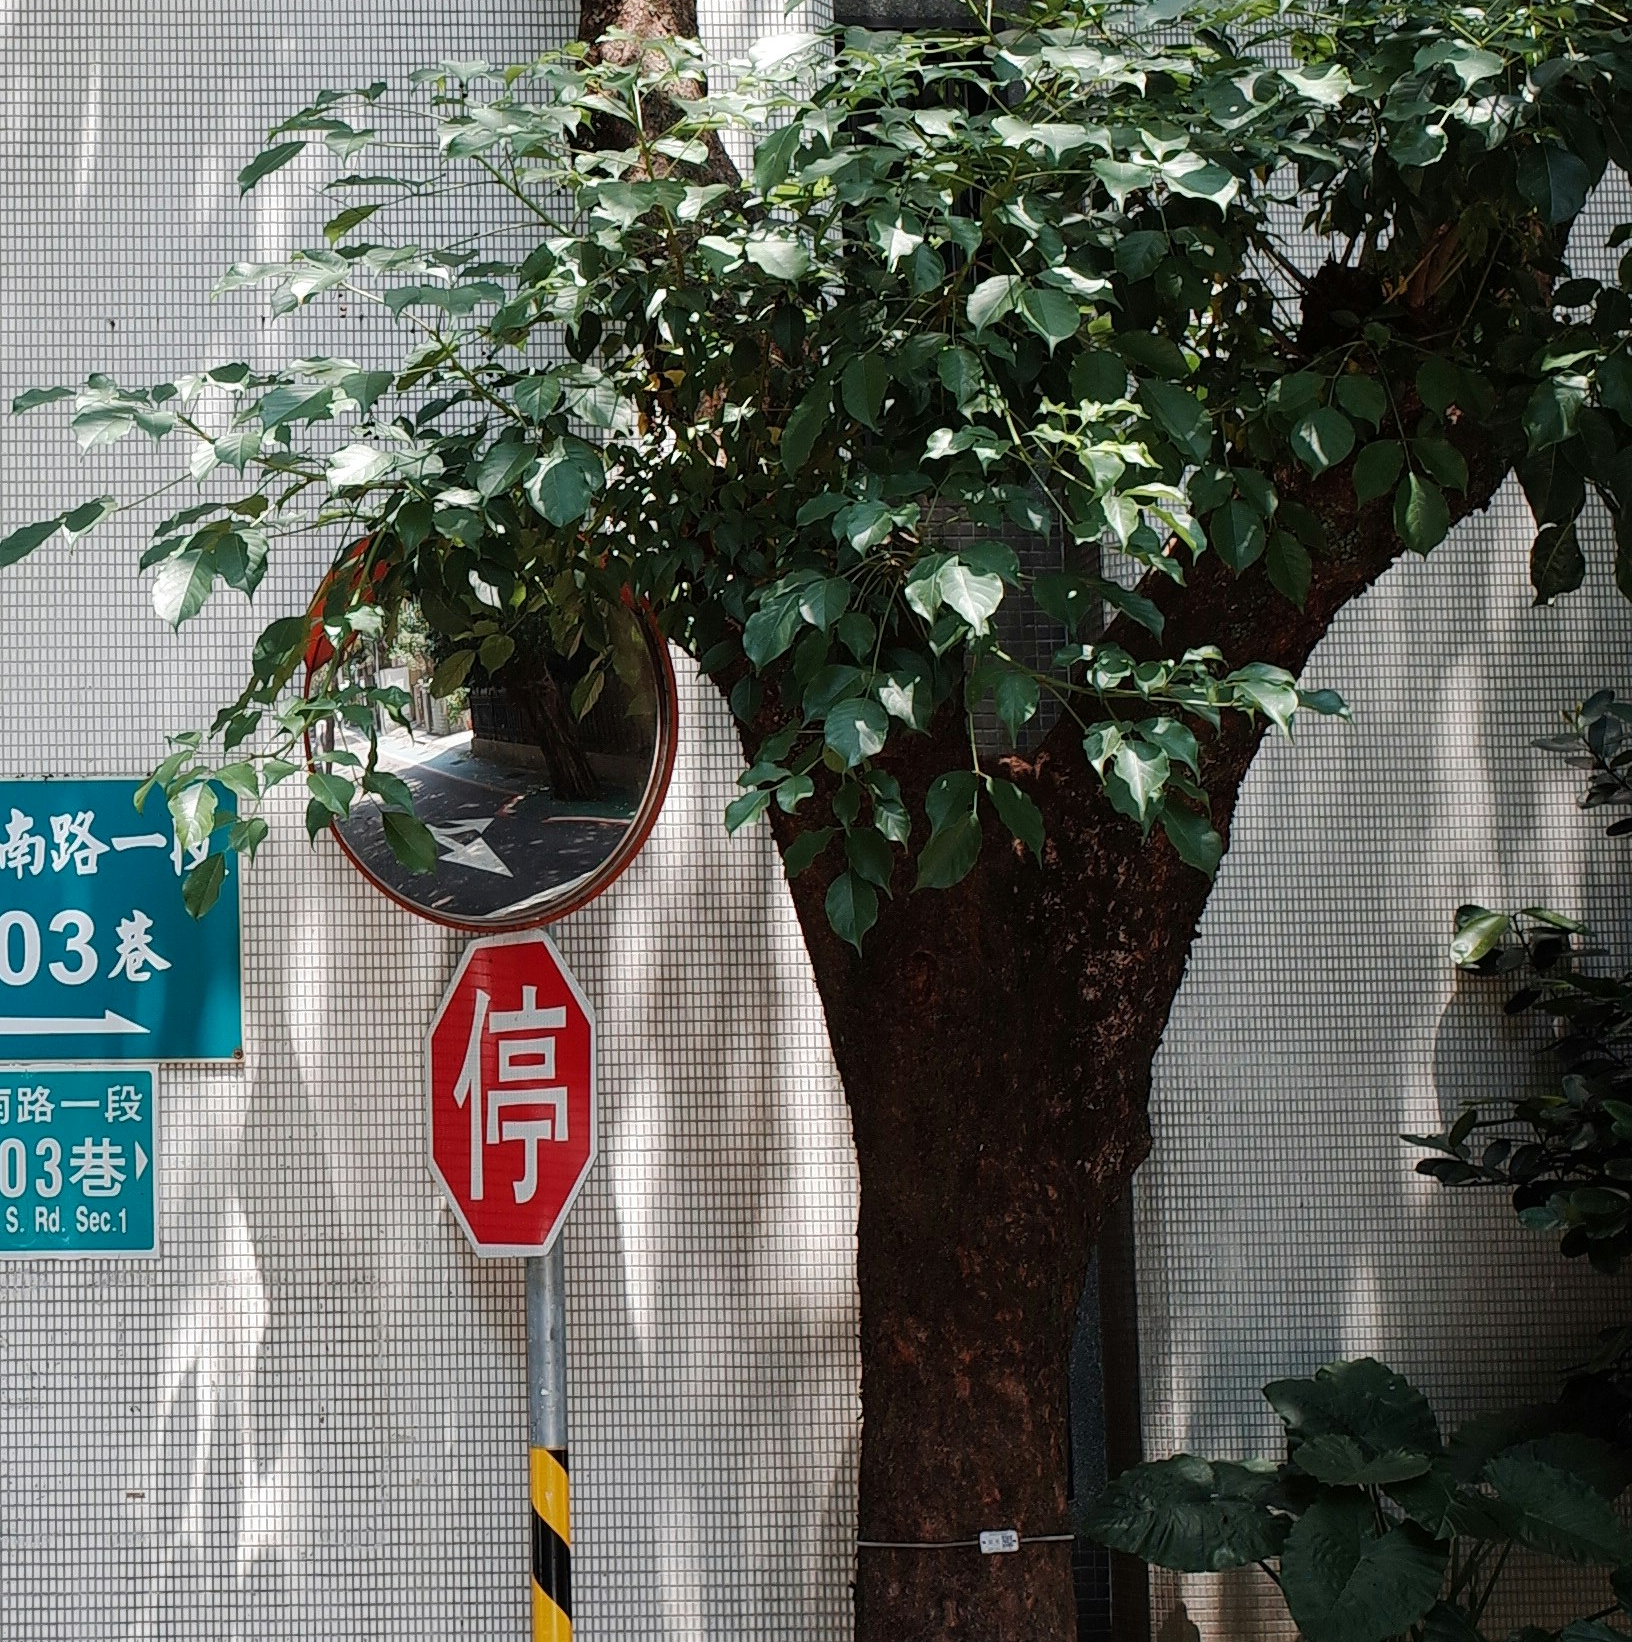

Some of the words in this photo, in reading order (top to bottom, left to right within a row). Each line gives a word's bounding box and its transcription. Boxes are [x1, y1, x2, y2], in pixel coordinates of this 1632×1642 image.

[452, 985, 570, 1204] 停
[6, 1207, 25, 1233] S.
[35, 1206, 66, 1233] Rd.
[76, 1206, 128, 1234] Sec.1
